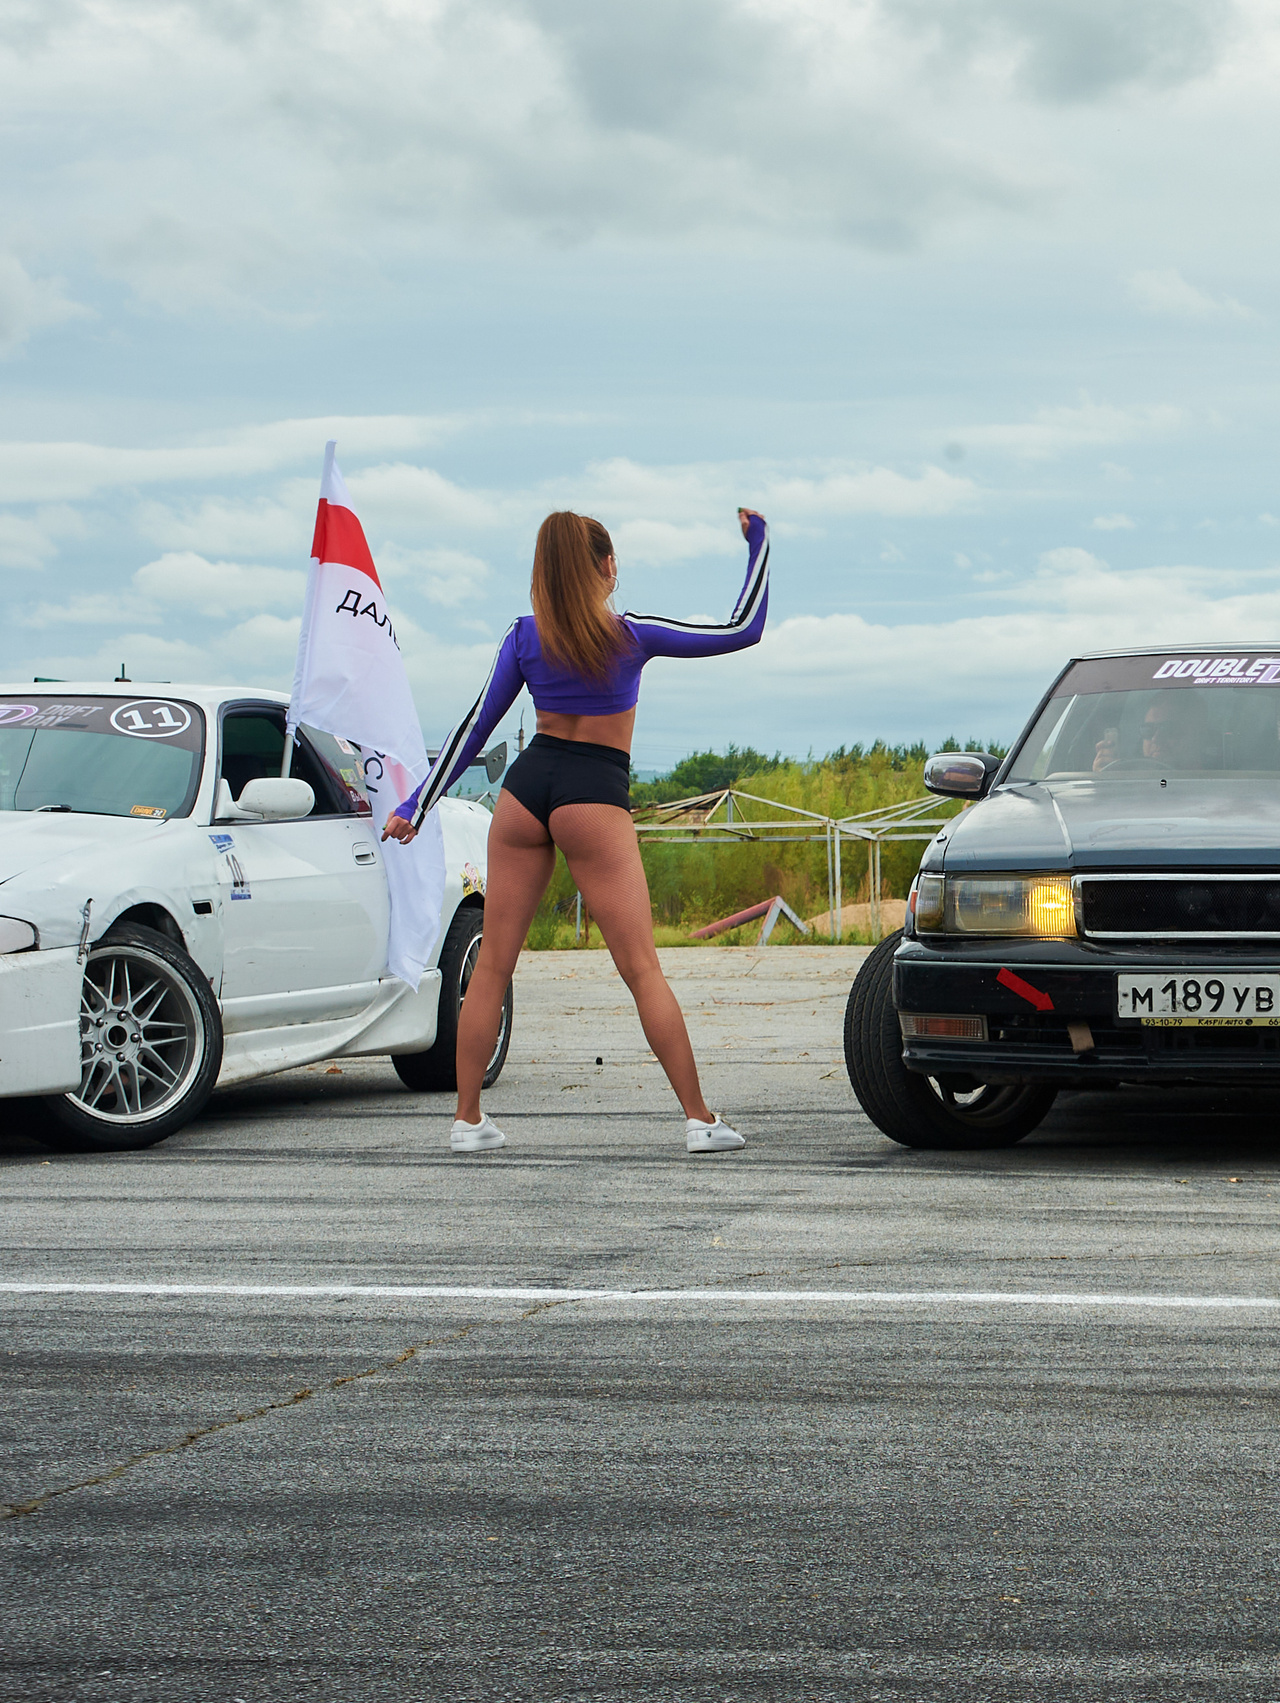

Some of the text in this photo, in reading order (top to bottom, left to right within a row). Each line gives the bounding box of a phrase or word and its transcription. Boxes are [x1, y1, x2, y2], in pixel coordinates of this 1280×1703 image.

[39, 704, 104, 718] DRIFT
[21, 715, 71, 727] DAY
[122, 706, 183, 730] 11
[1145, 1018, 1183, 1026] 93-10-79
